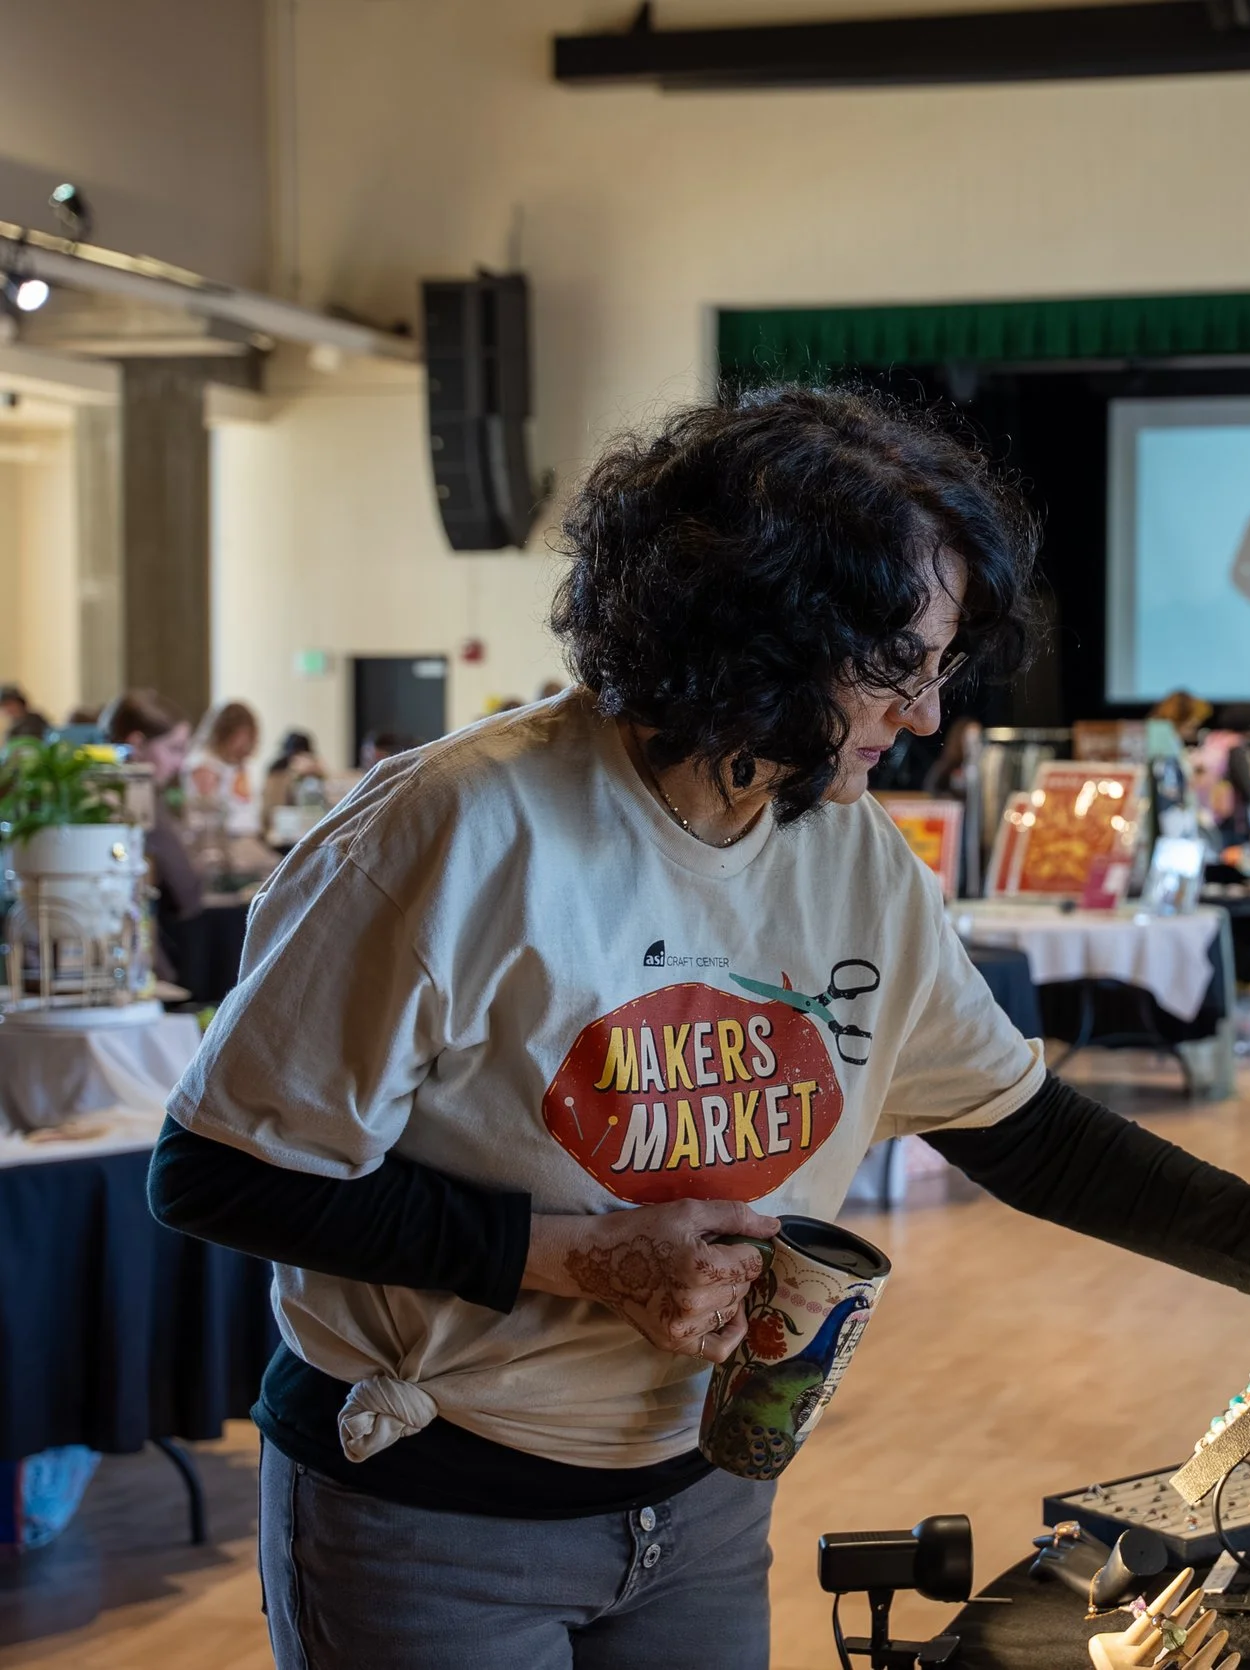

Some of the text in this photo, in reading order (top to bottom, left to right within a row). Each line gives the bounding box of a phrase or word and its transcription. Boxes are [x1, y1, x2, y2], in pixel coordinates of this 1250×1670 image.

[646, 951, 730, 968] asi CRAFT CENTER
[594, 1015, 776, 1092] MAKERS
[611, 1080, 819, 1172] MARKET
